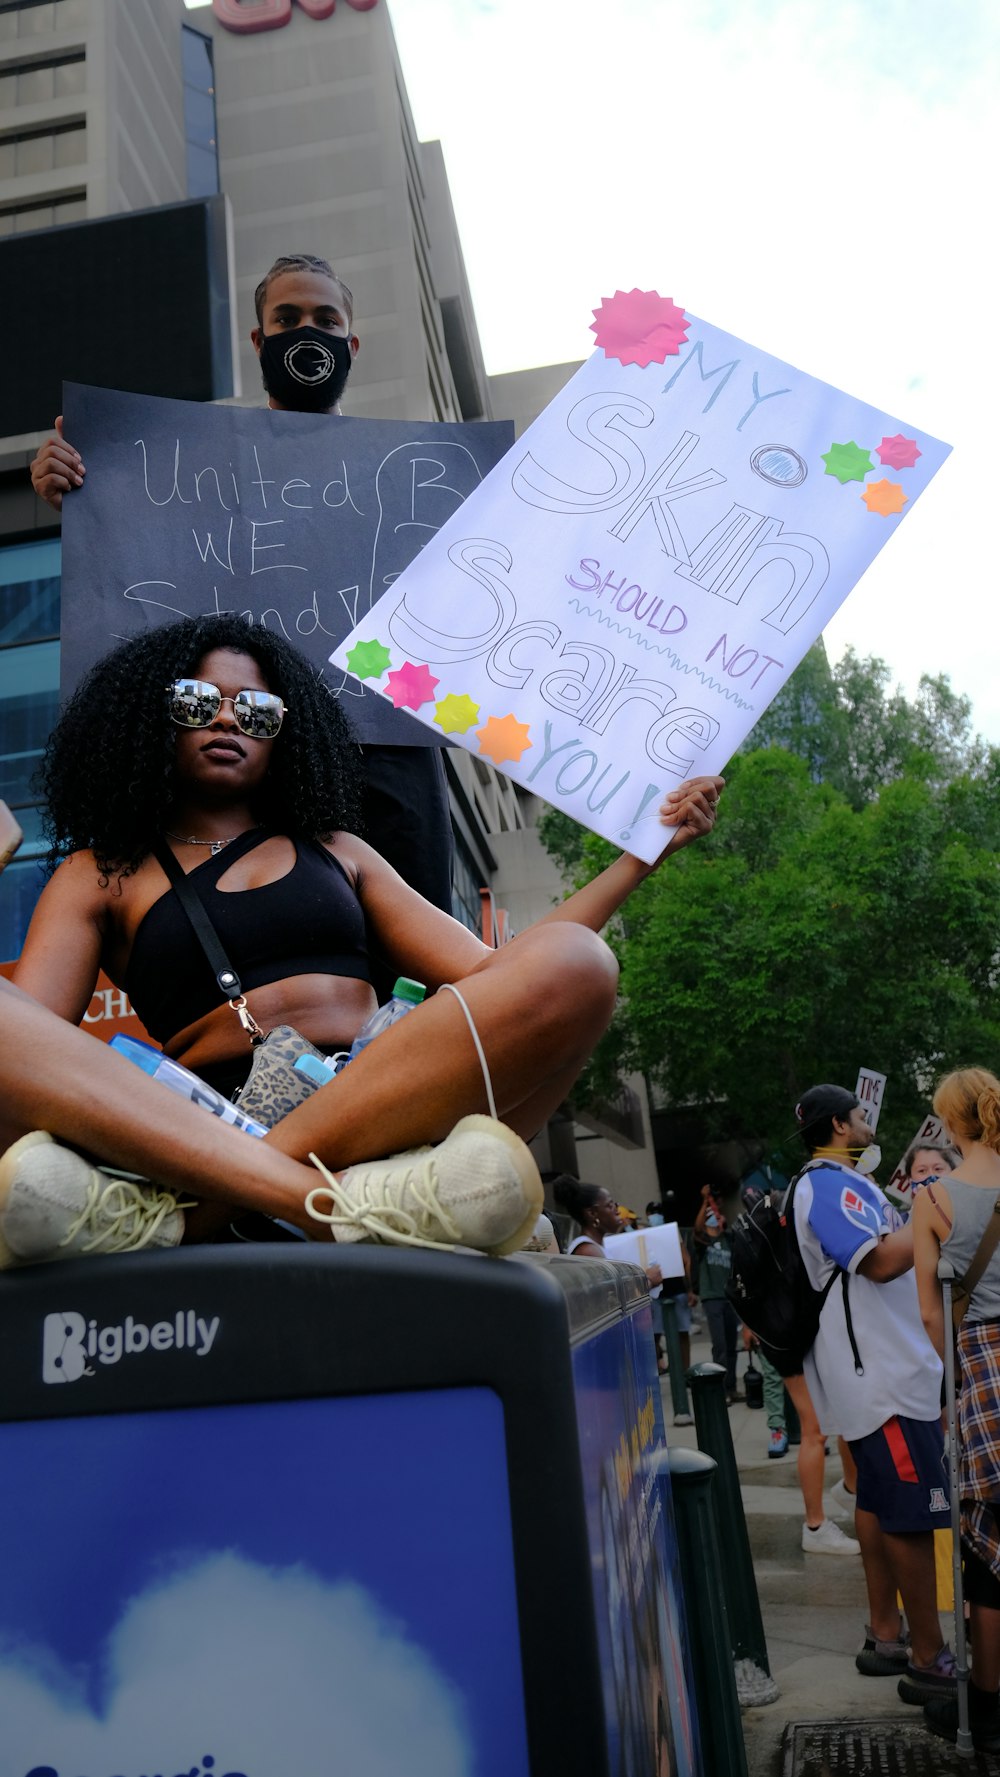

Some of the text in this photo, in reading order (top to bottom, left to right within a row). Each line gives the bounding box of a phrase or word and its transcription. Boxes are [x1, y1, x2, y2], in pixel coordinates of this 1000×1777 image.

[662, 339, 792, 432] MY
[134, 438, 365, 516] United
[511, 391, 831, 635] Skin
[192, 516, 309, 576] WE
[388, 537, 721, 777] Scare
[564, 558, 785, 690] SHOULD NOT
[42, 1309, 220, 1384] Bigbelly
[929, 1487, 951, 1513] A
